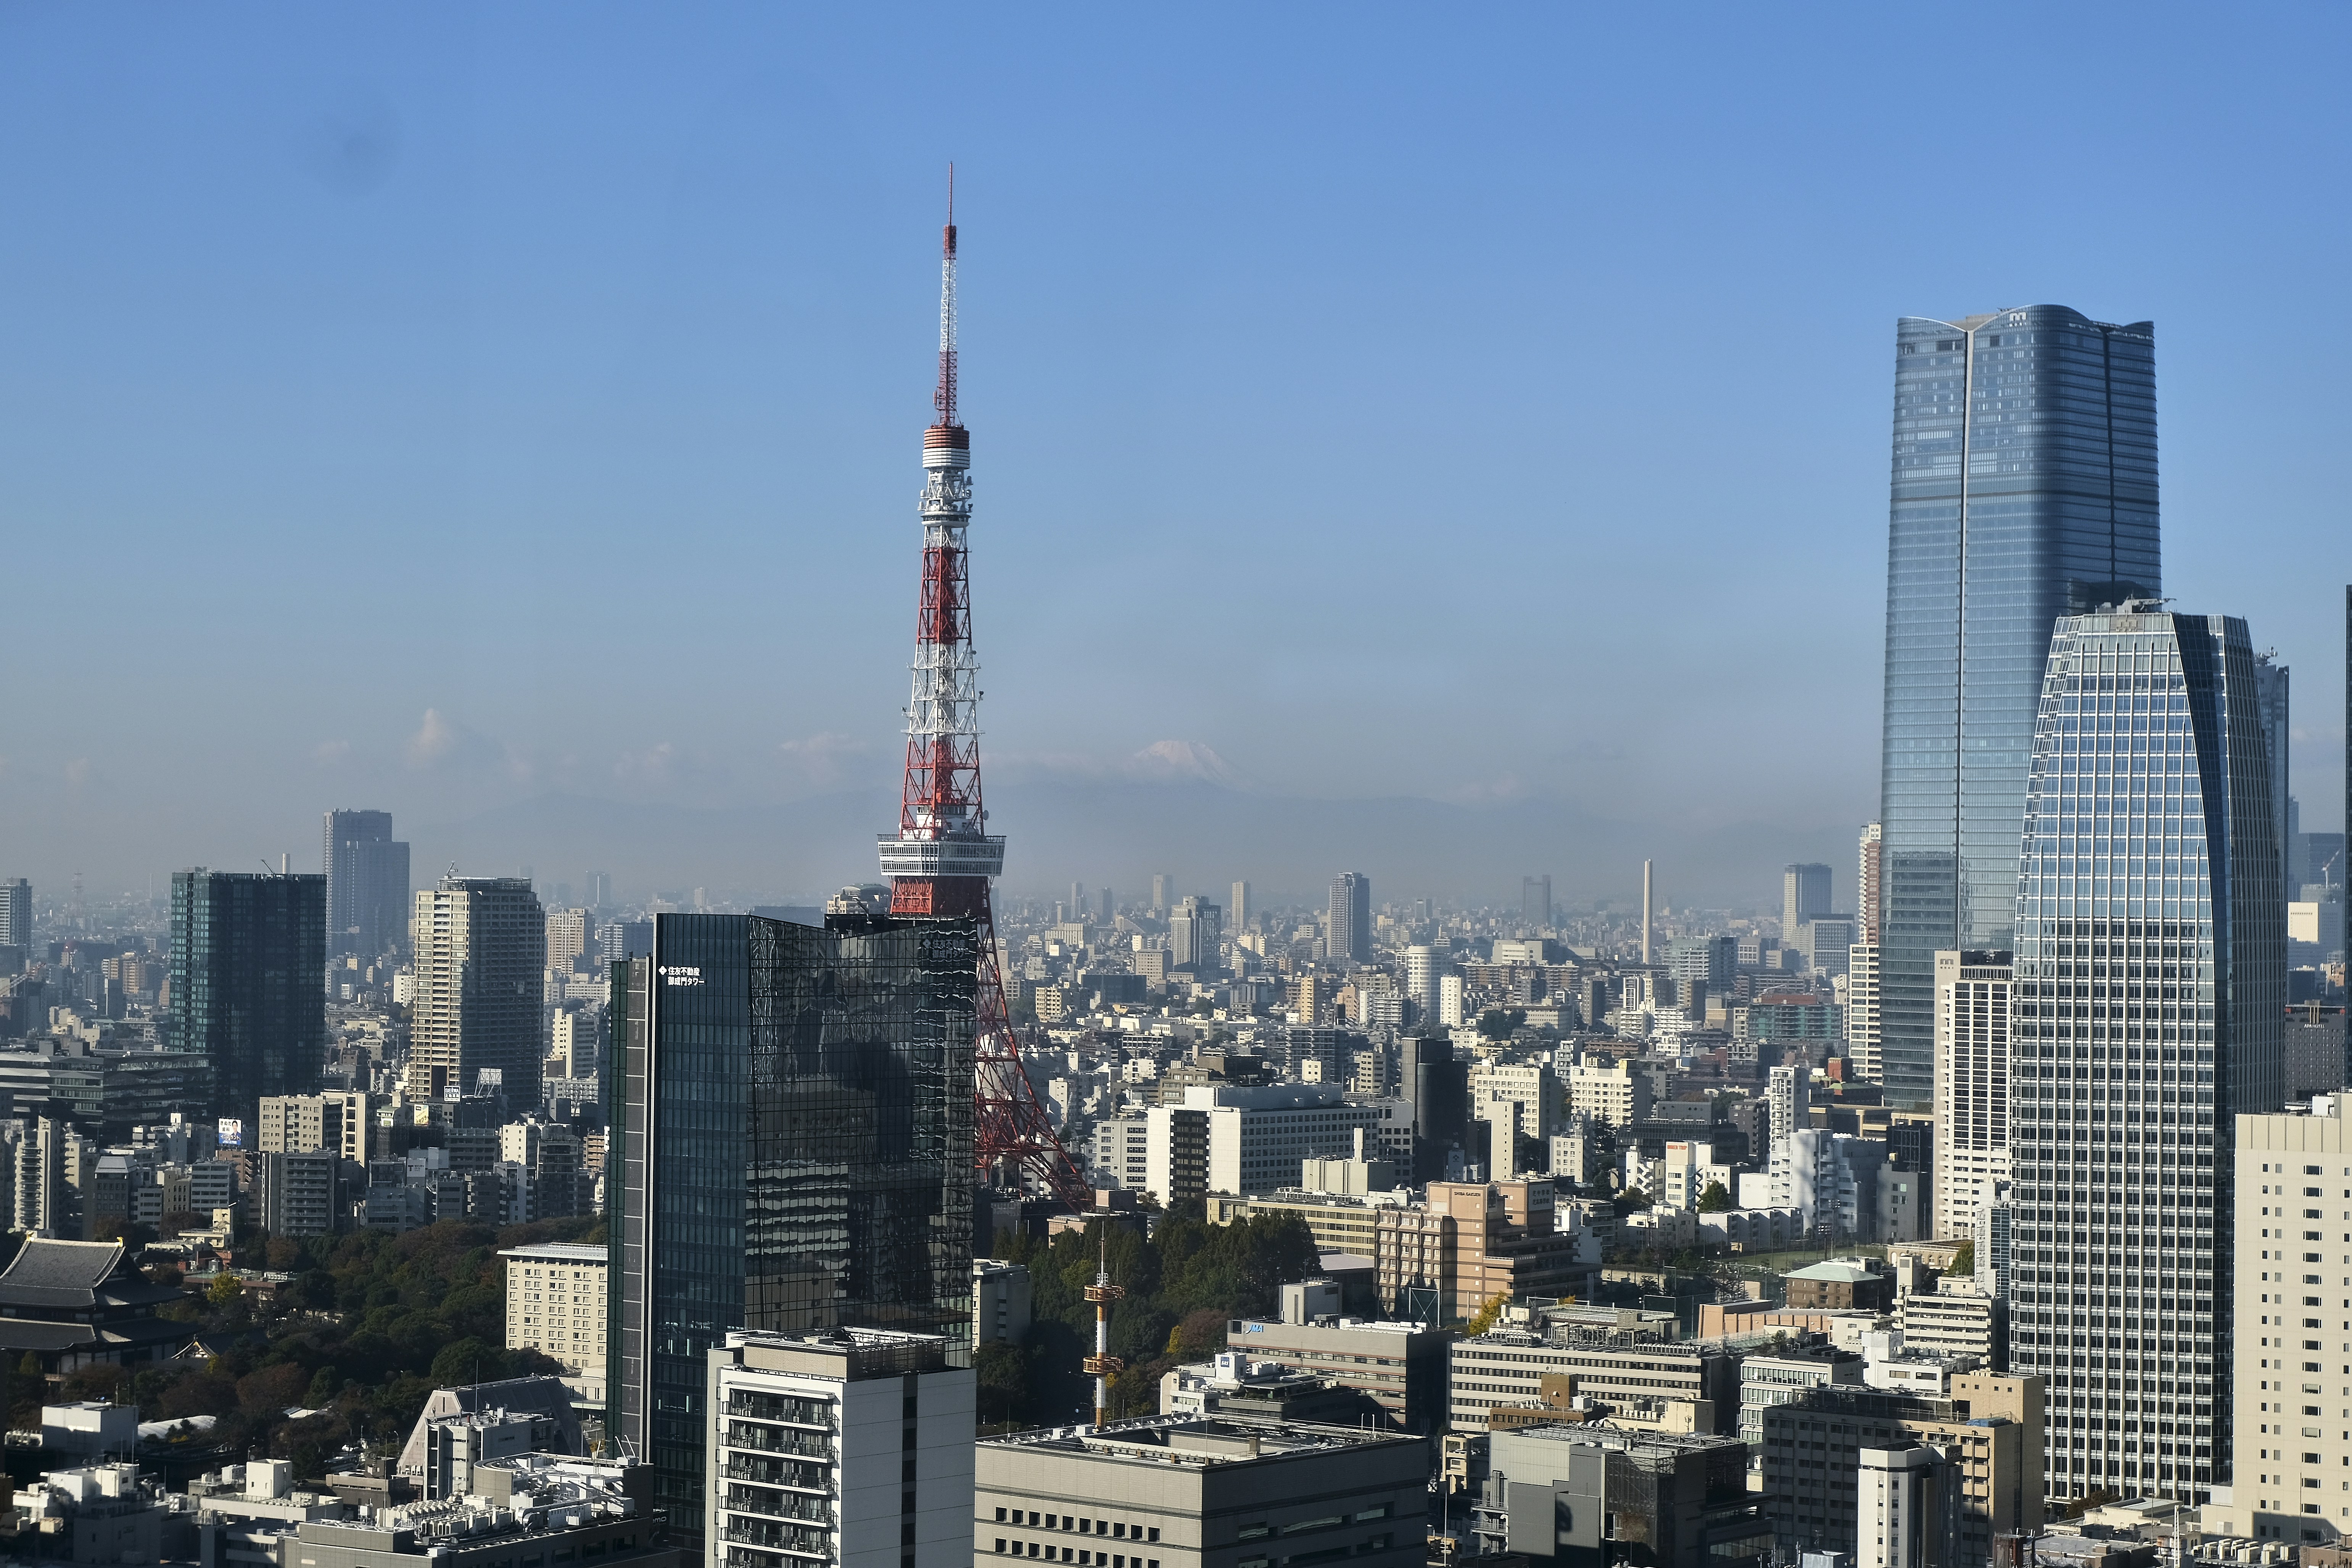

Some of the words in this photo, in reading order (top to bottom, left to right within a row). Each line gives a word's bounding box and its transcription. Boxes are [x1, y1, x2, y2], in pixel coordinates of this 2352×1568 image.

[932, 939, 965, 948] 住友不動産
[932, 949, 970, 958] 御成門タワー
[668, 966, 700, 976] 住友不動産
[668, 976, 705, 986] 御成門タワー
[1246, 1324, 1264, 1334] JMA
